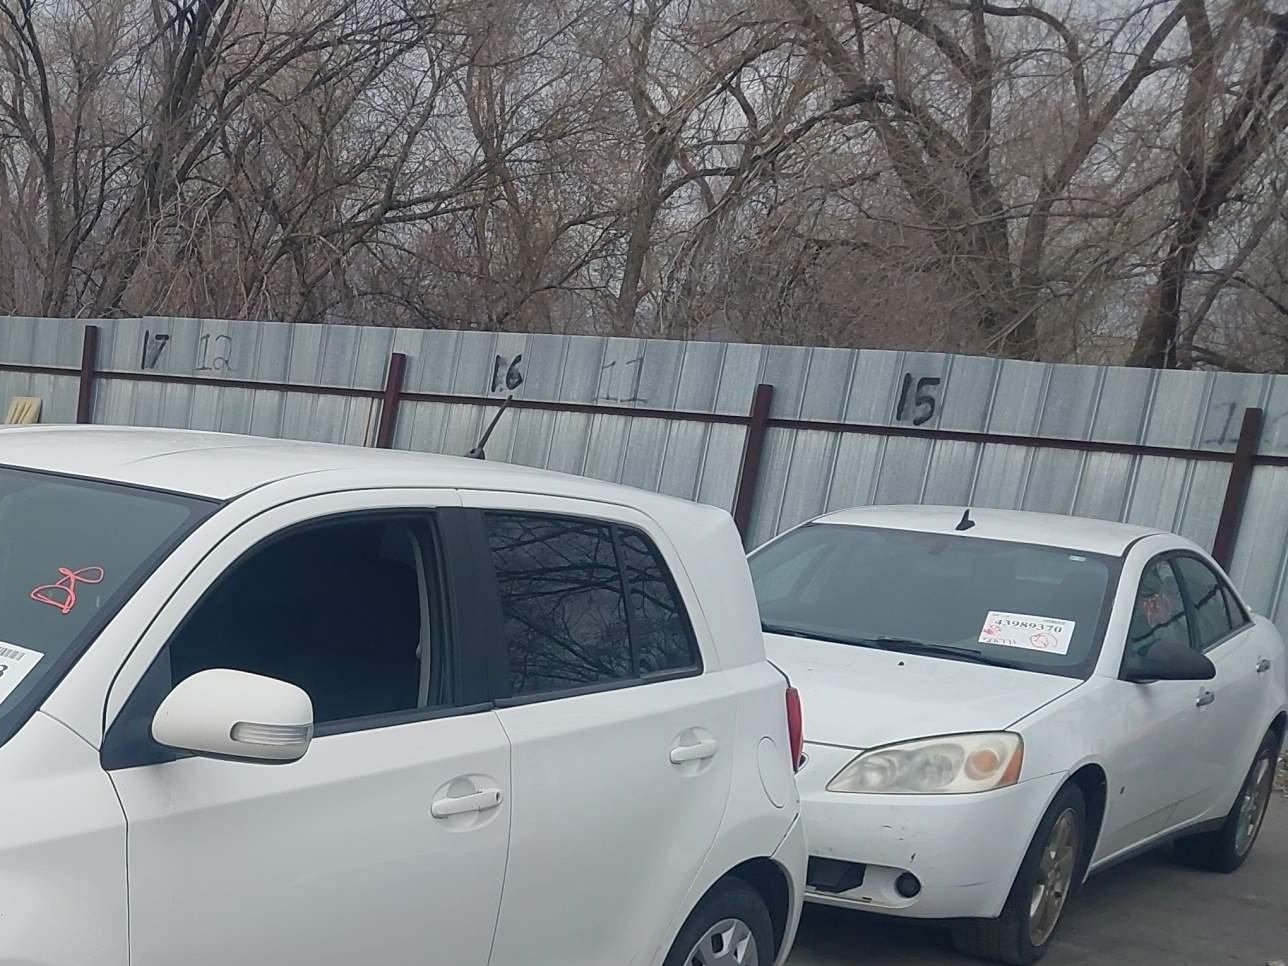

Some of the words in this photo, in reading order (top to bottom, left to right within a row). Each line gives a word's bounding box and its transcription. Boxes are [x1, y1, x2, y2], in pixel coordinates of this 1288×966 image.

[140, 329, 170, 371] 17
[196, 333, 233, 371] 12
[490, 353, 524, 393] 16
[895, 371, 941, 427] 15
